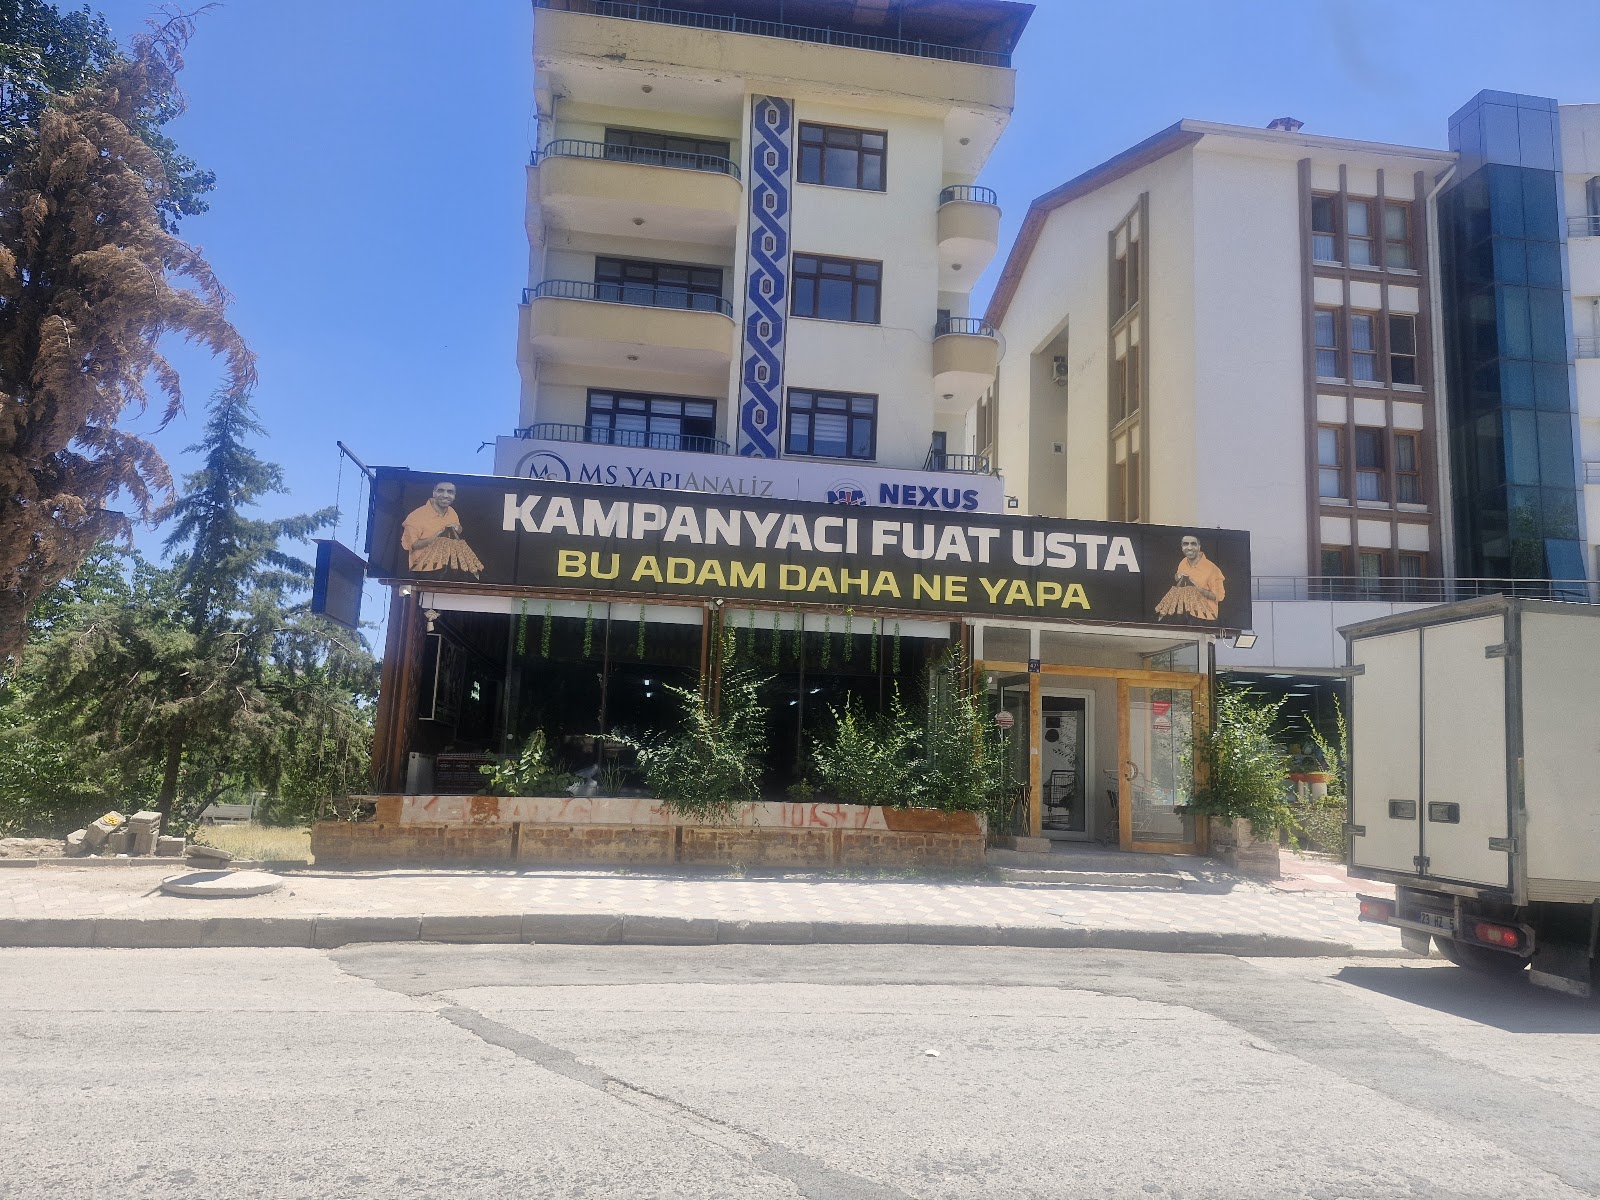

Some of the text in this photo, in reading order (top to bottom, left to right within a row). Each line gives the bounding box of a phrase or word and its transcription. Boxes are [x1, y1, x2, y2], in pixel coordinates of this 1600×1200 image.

[579, 463, 618, 484] MS
[879, 483, 979, 510] NEXUS
[502, 493, 1141, 573] KAMPANYACI FUAT USTA
[557, 550, 1091, 610] BU ADAM DAHA NE YAPA
[1421, 913, 1430, 925] 23
